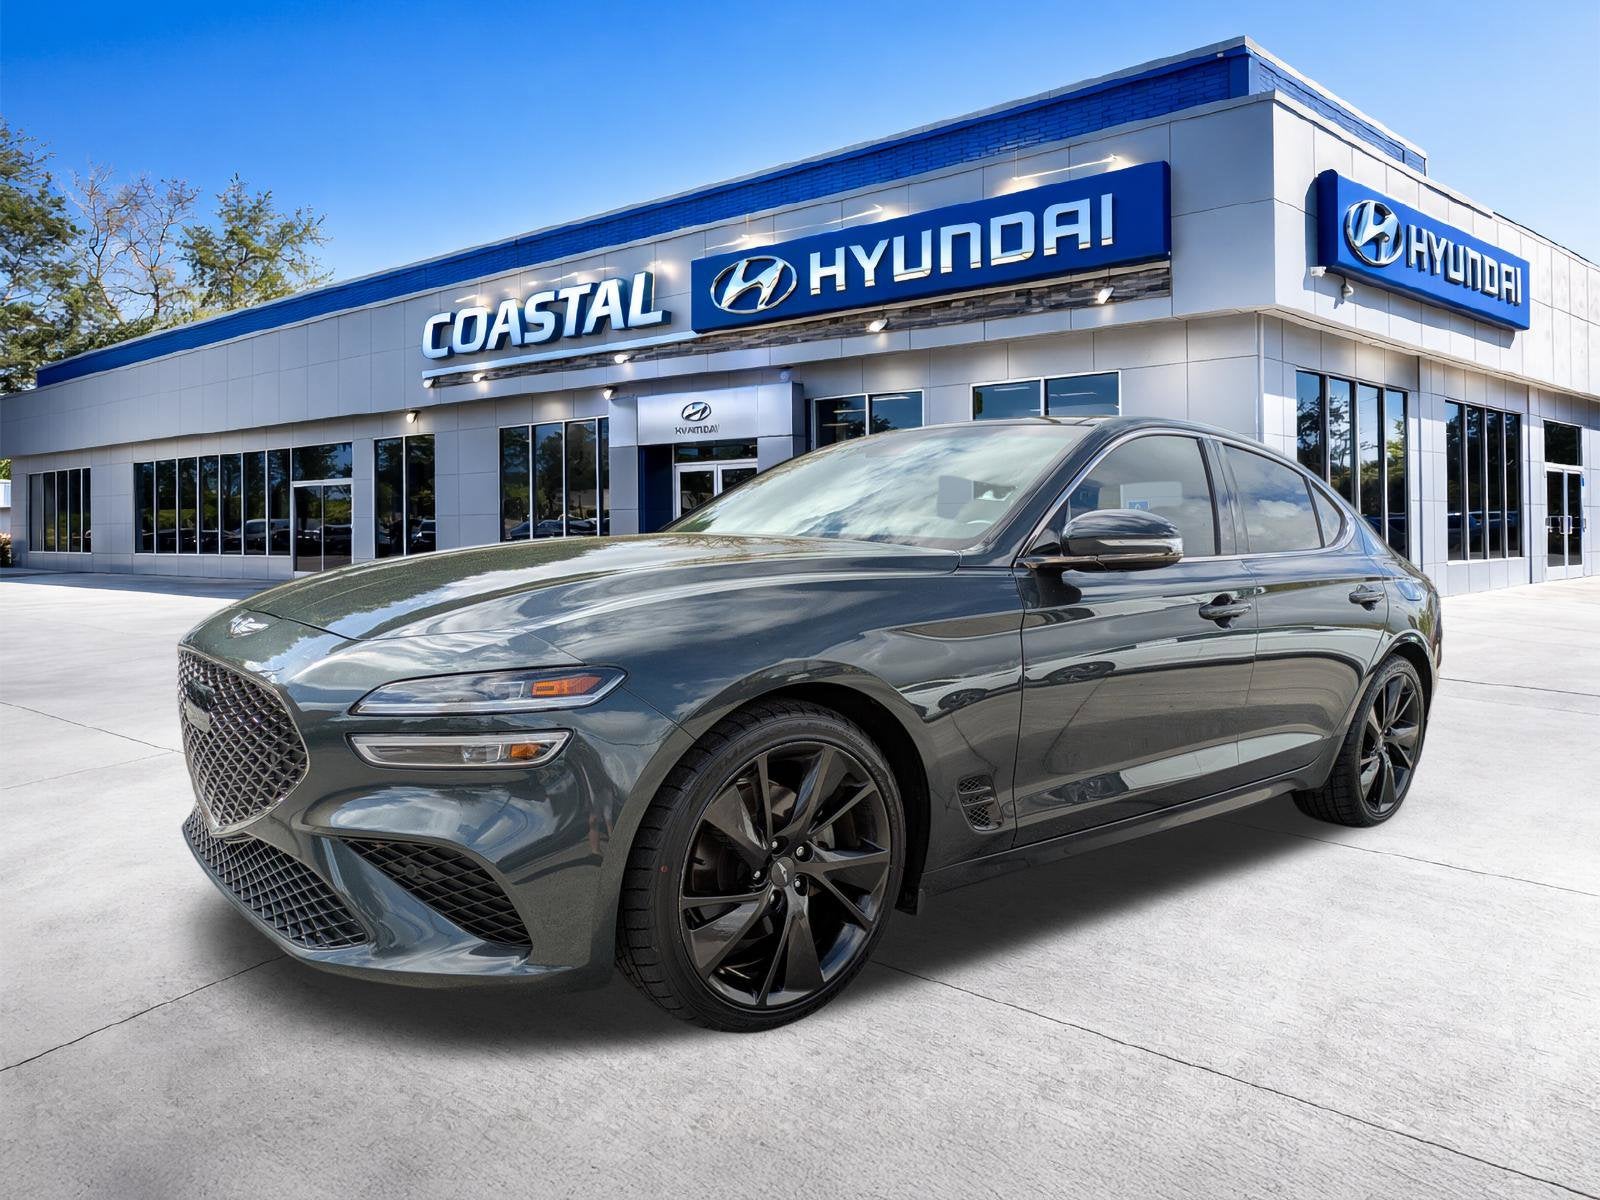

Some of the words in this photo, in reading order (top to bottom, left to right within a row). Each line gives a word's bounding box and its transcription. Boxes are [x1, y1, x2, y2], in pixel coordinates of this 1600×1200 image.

[810, 193, 1113, 295] HYUNDAI
[1406, 224, 1522, 306] HYUNDAI
[422, 272, 671, 359] COASTAL
